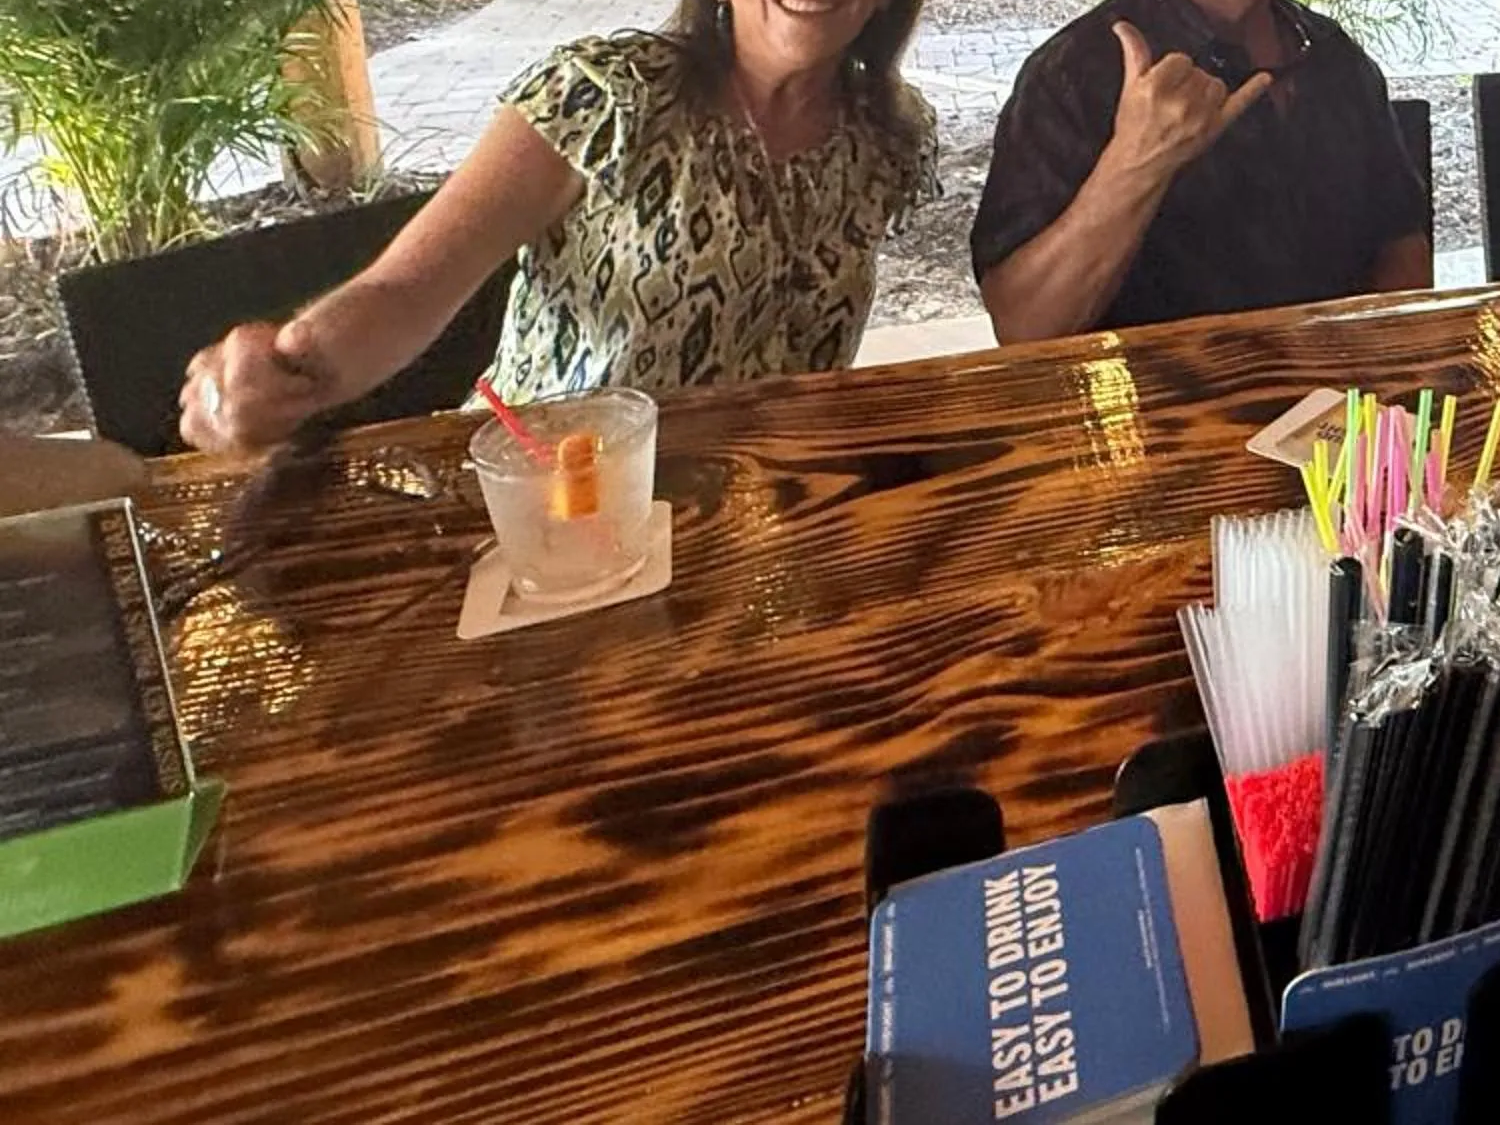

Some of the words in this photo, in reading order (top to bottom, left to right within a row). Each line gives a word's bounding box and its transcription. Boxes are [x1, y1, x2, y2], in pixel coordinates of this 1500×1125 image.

[984, 870, 1025, 969] DRINK
[1022, 863, 1064, 959] ENJOY
[989, 970, 1027, 1020] TO
[1029, 958, 1068, 1008] TO
[991, 1024, 1036, 1119] EASY
[1033, 1011, 1078, 1103] EASY
[1388, 1057, 1428, 1091] TO
[1392, 1027, 1433, 1062] TO
